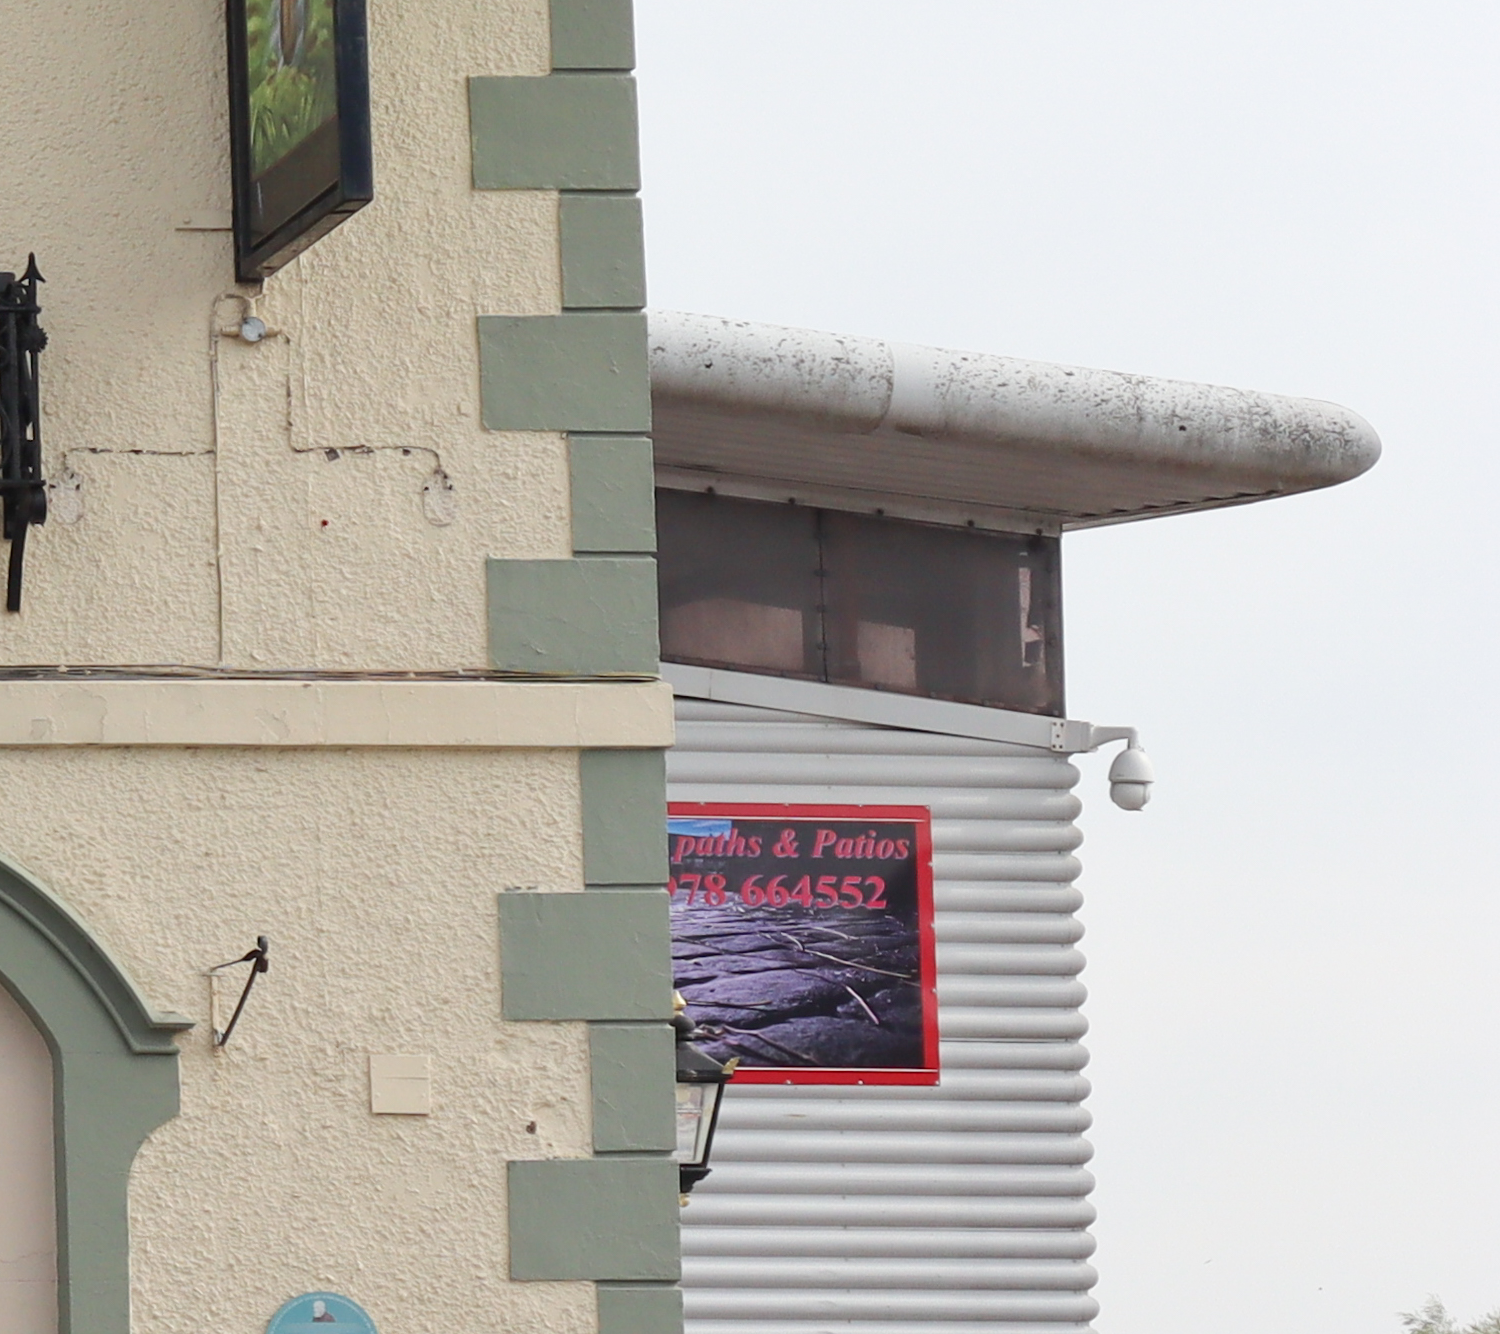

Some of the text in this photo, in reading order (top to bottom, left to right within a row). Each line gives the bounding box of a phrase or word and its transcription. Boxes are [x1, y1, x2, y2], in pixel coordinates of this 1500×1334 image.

[772, 828, 800, 858] &
[811, 829, 911, 860] Patios
[740, 874, 888, 910] 664552
